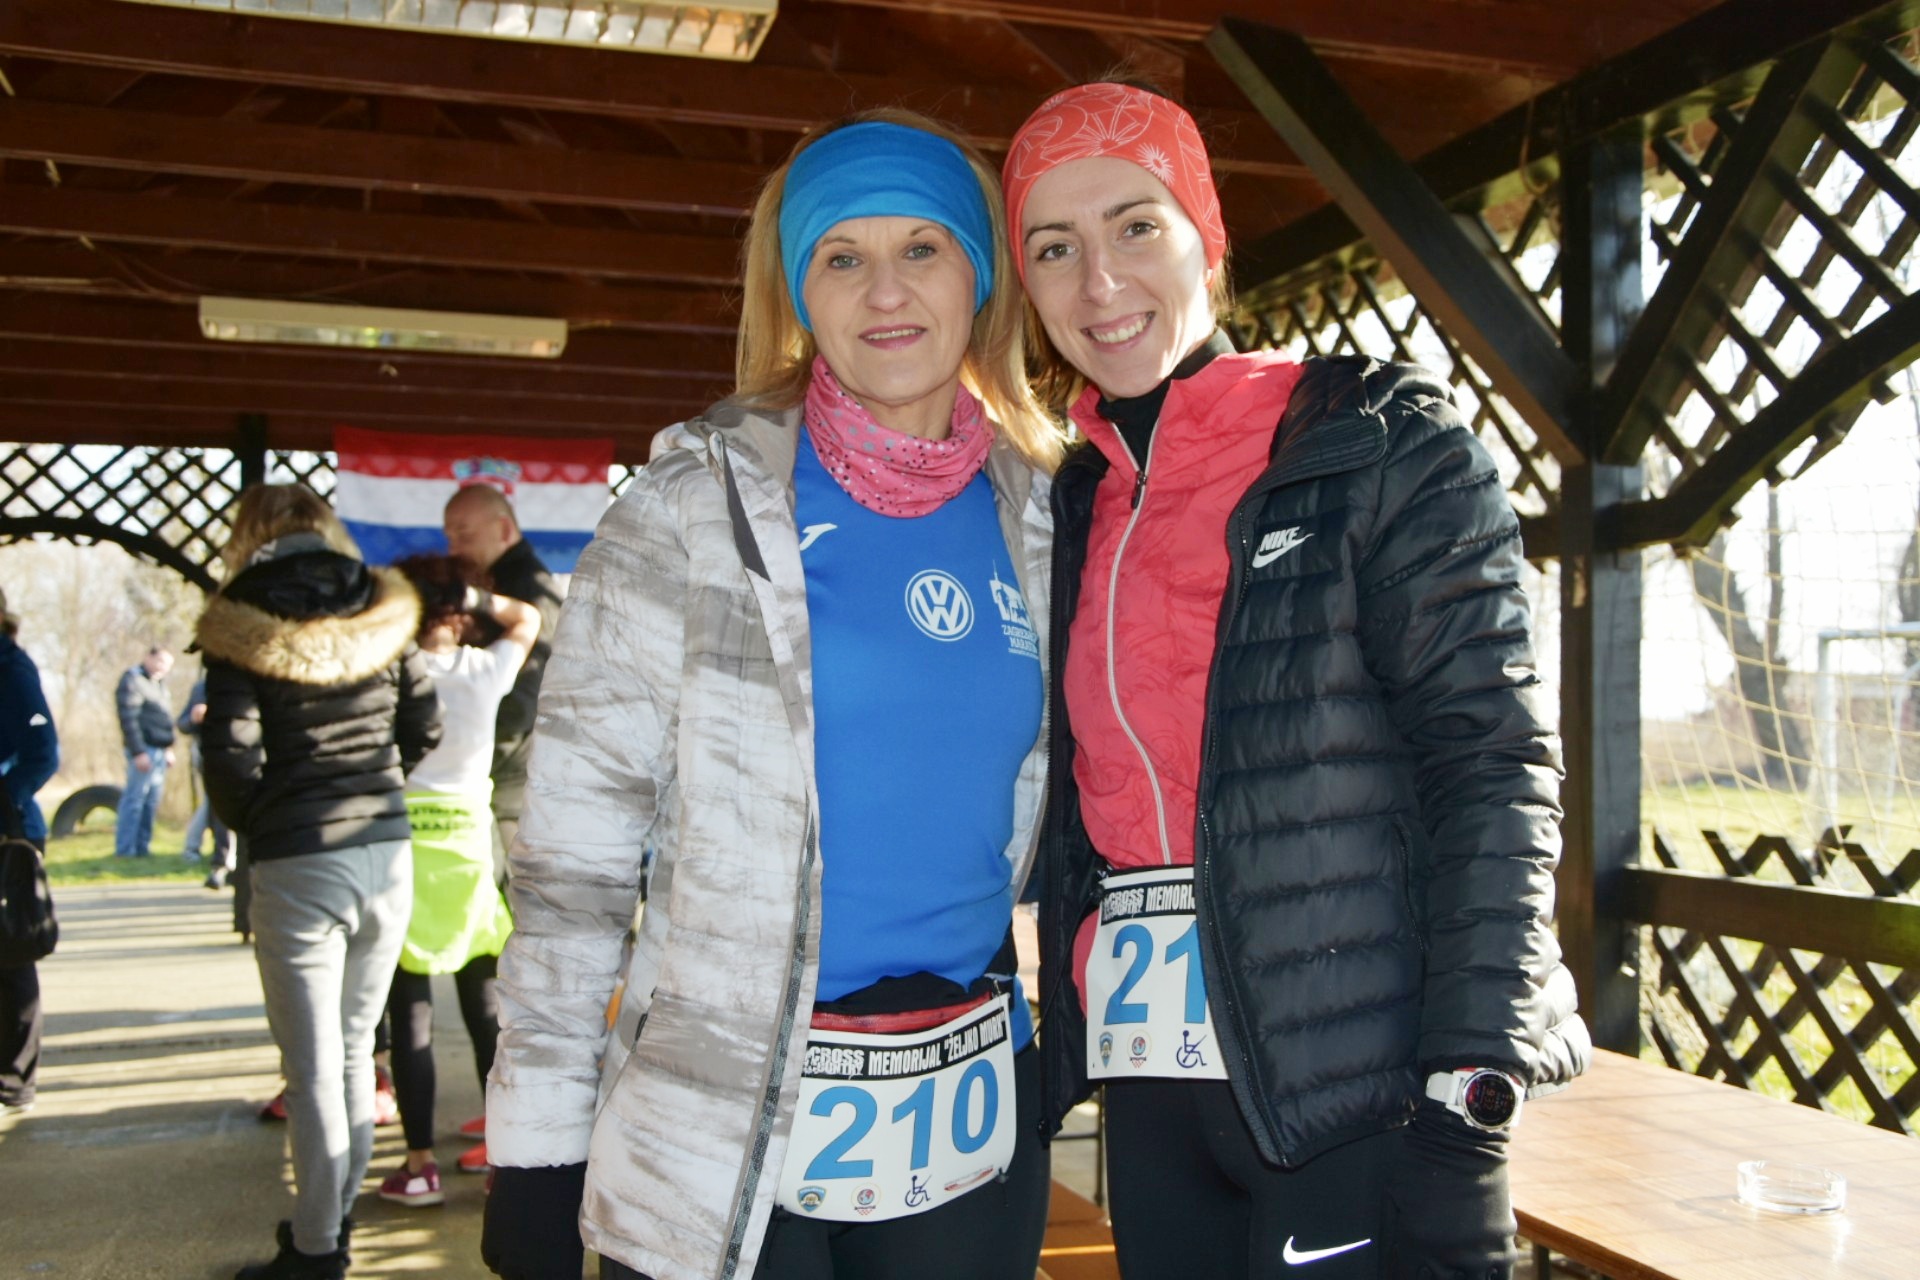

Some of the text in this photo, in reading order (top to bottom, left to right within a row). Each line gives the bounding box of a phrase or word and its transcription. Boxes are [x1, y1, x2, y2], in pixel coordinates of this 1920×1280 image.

[1259, 526, 1301, 552] NIKE
[808, 1046, 864, 1064] CROSS
[868, 1043, 942, 1076] MEMORIJAL
[803, 1058, 998, 1181] 210
